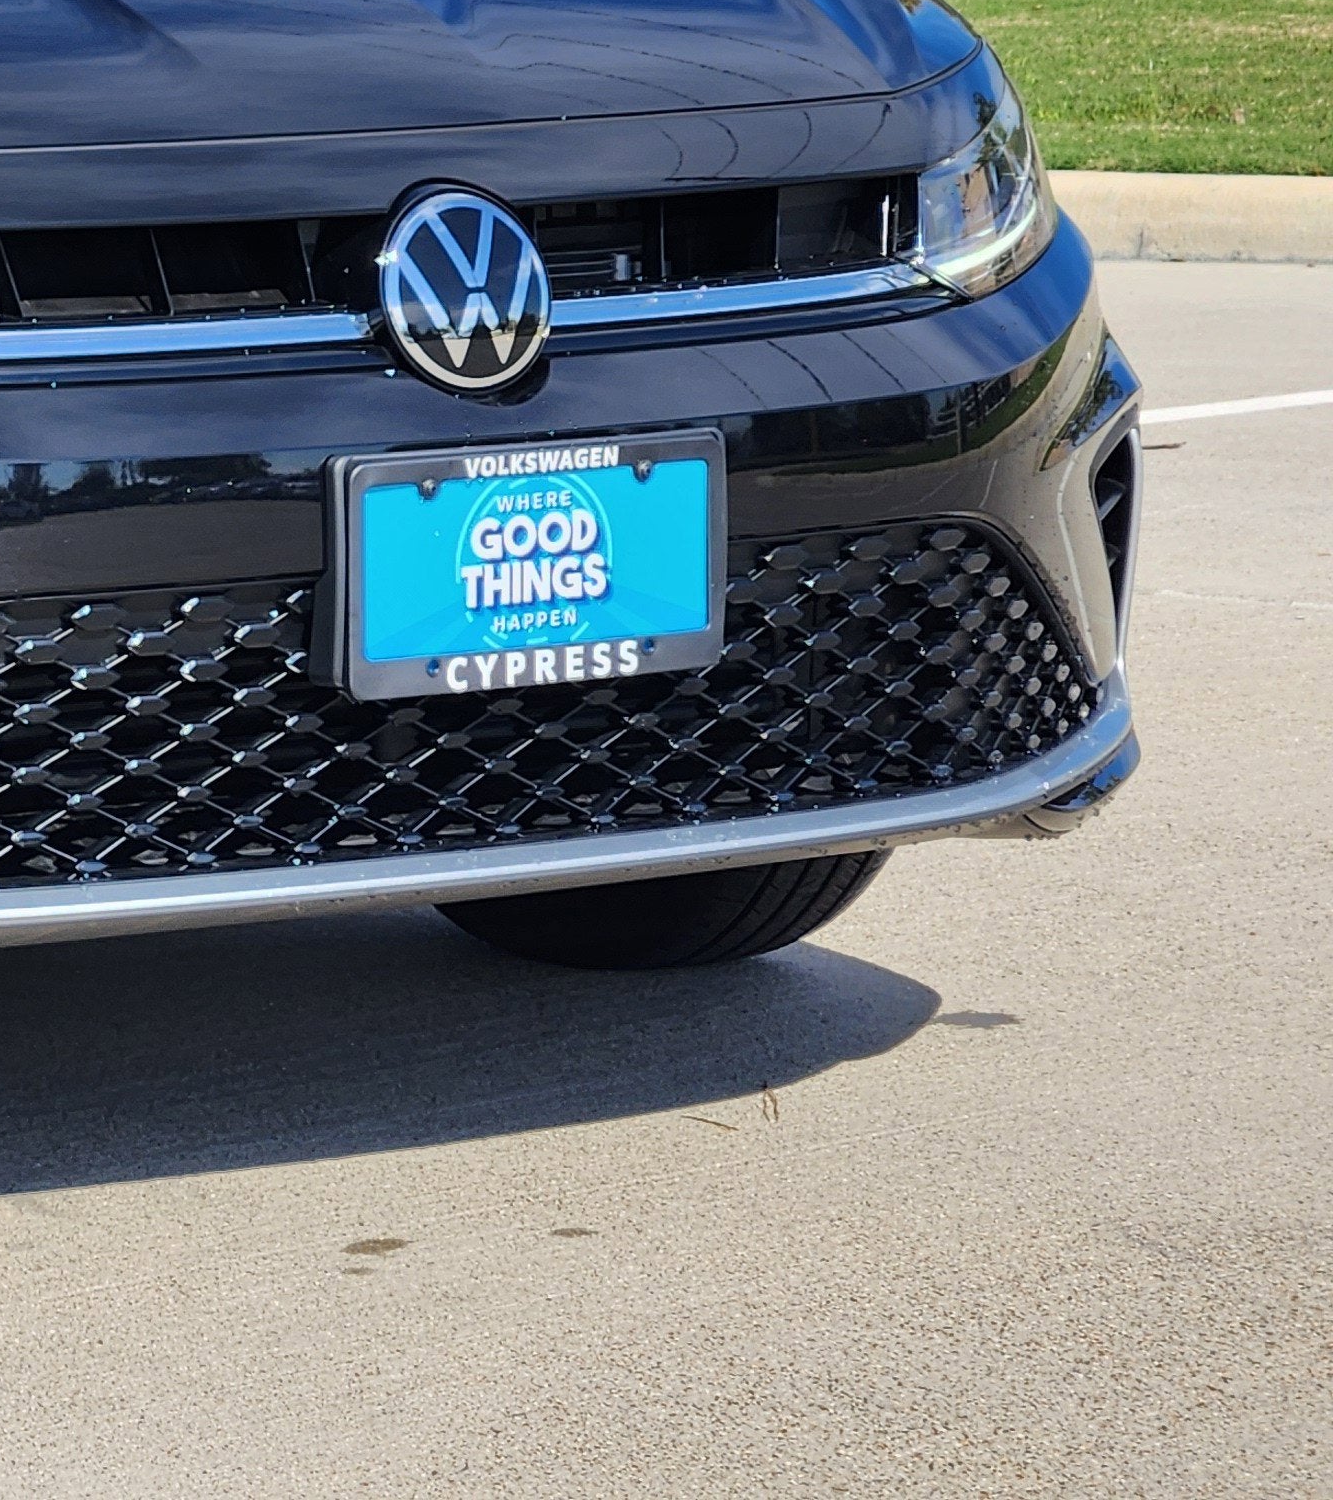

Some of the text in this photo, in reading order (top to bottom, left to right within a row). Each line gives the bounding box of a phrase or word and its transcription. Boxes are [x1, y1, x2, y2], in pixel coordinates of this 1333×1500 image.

[388, 193, 548, 385] VW
[464, 444, 620, 480] VOLKSWAGEN
[496, 489, 574, 513] WHERE
[470, 508, 598, 561] GOOD
[460, 553, 608, 609] THINGS
[492, 605, 578, 633] HAPPEN
[446, 640, 639, 693] CYPRESS
